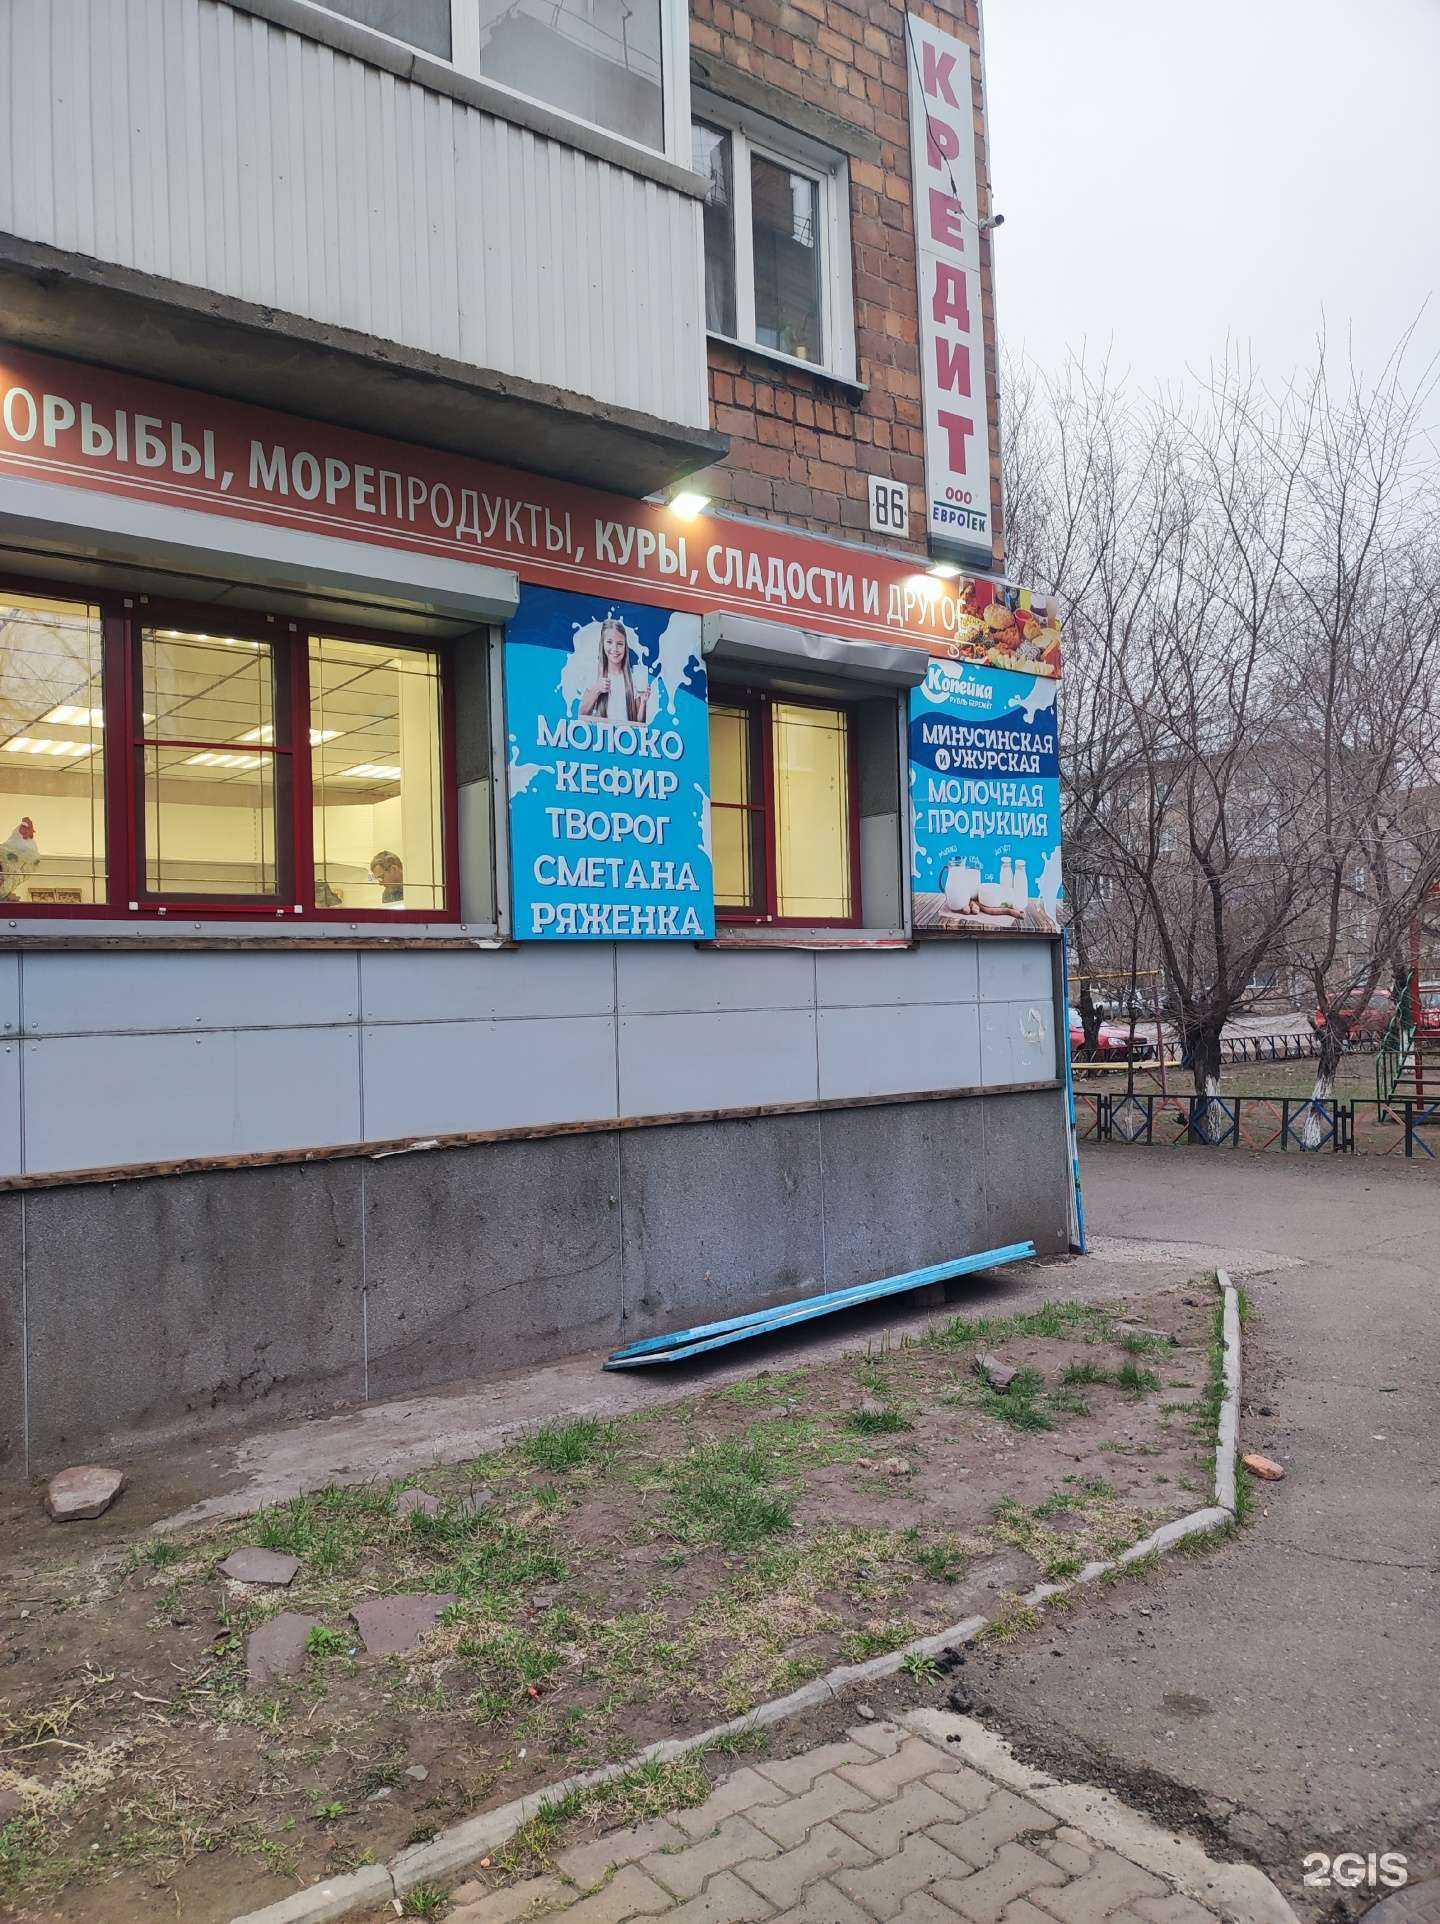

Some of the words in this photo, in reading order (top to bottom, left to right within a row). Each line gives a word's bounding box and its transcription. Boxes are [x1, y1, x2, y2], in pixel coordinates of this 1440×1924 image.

[922, 40, 974, 475] КРЕДИТ
[875, 485, 904, 529] 86
[945, 486, 973, 505] ООО
[249, 440, 585, 563] МОРЕПРОДУКТЫ,
[595, 518, 698, 585] КУРЫ,
[706, 544, 855, 611] СЛАДОСТИ
[862, 577, 880, 616] И
[932, 507, 987, 533] ЕВРОТЕК
[536, 714, 684, 761] МОЛОКО
[922, 723, 1054, 754] МИНУСИНСКАЯ
[951, 748, 1041, 774] УЖУРСКАЯ
[555, 760, 679, 800] КЕФИР
[928, 778, 1044, 808] МОЛОЧНАЯ
[545, 806, 672, 845] ТВОРОГ
[927, 809, 1049, 839] ПРОДУКЦИЯ
[533, 854, 701, 891] СМЕТАНА
[530, 902, 705, 936] РЯЖЕНКА
